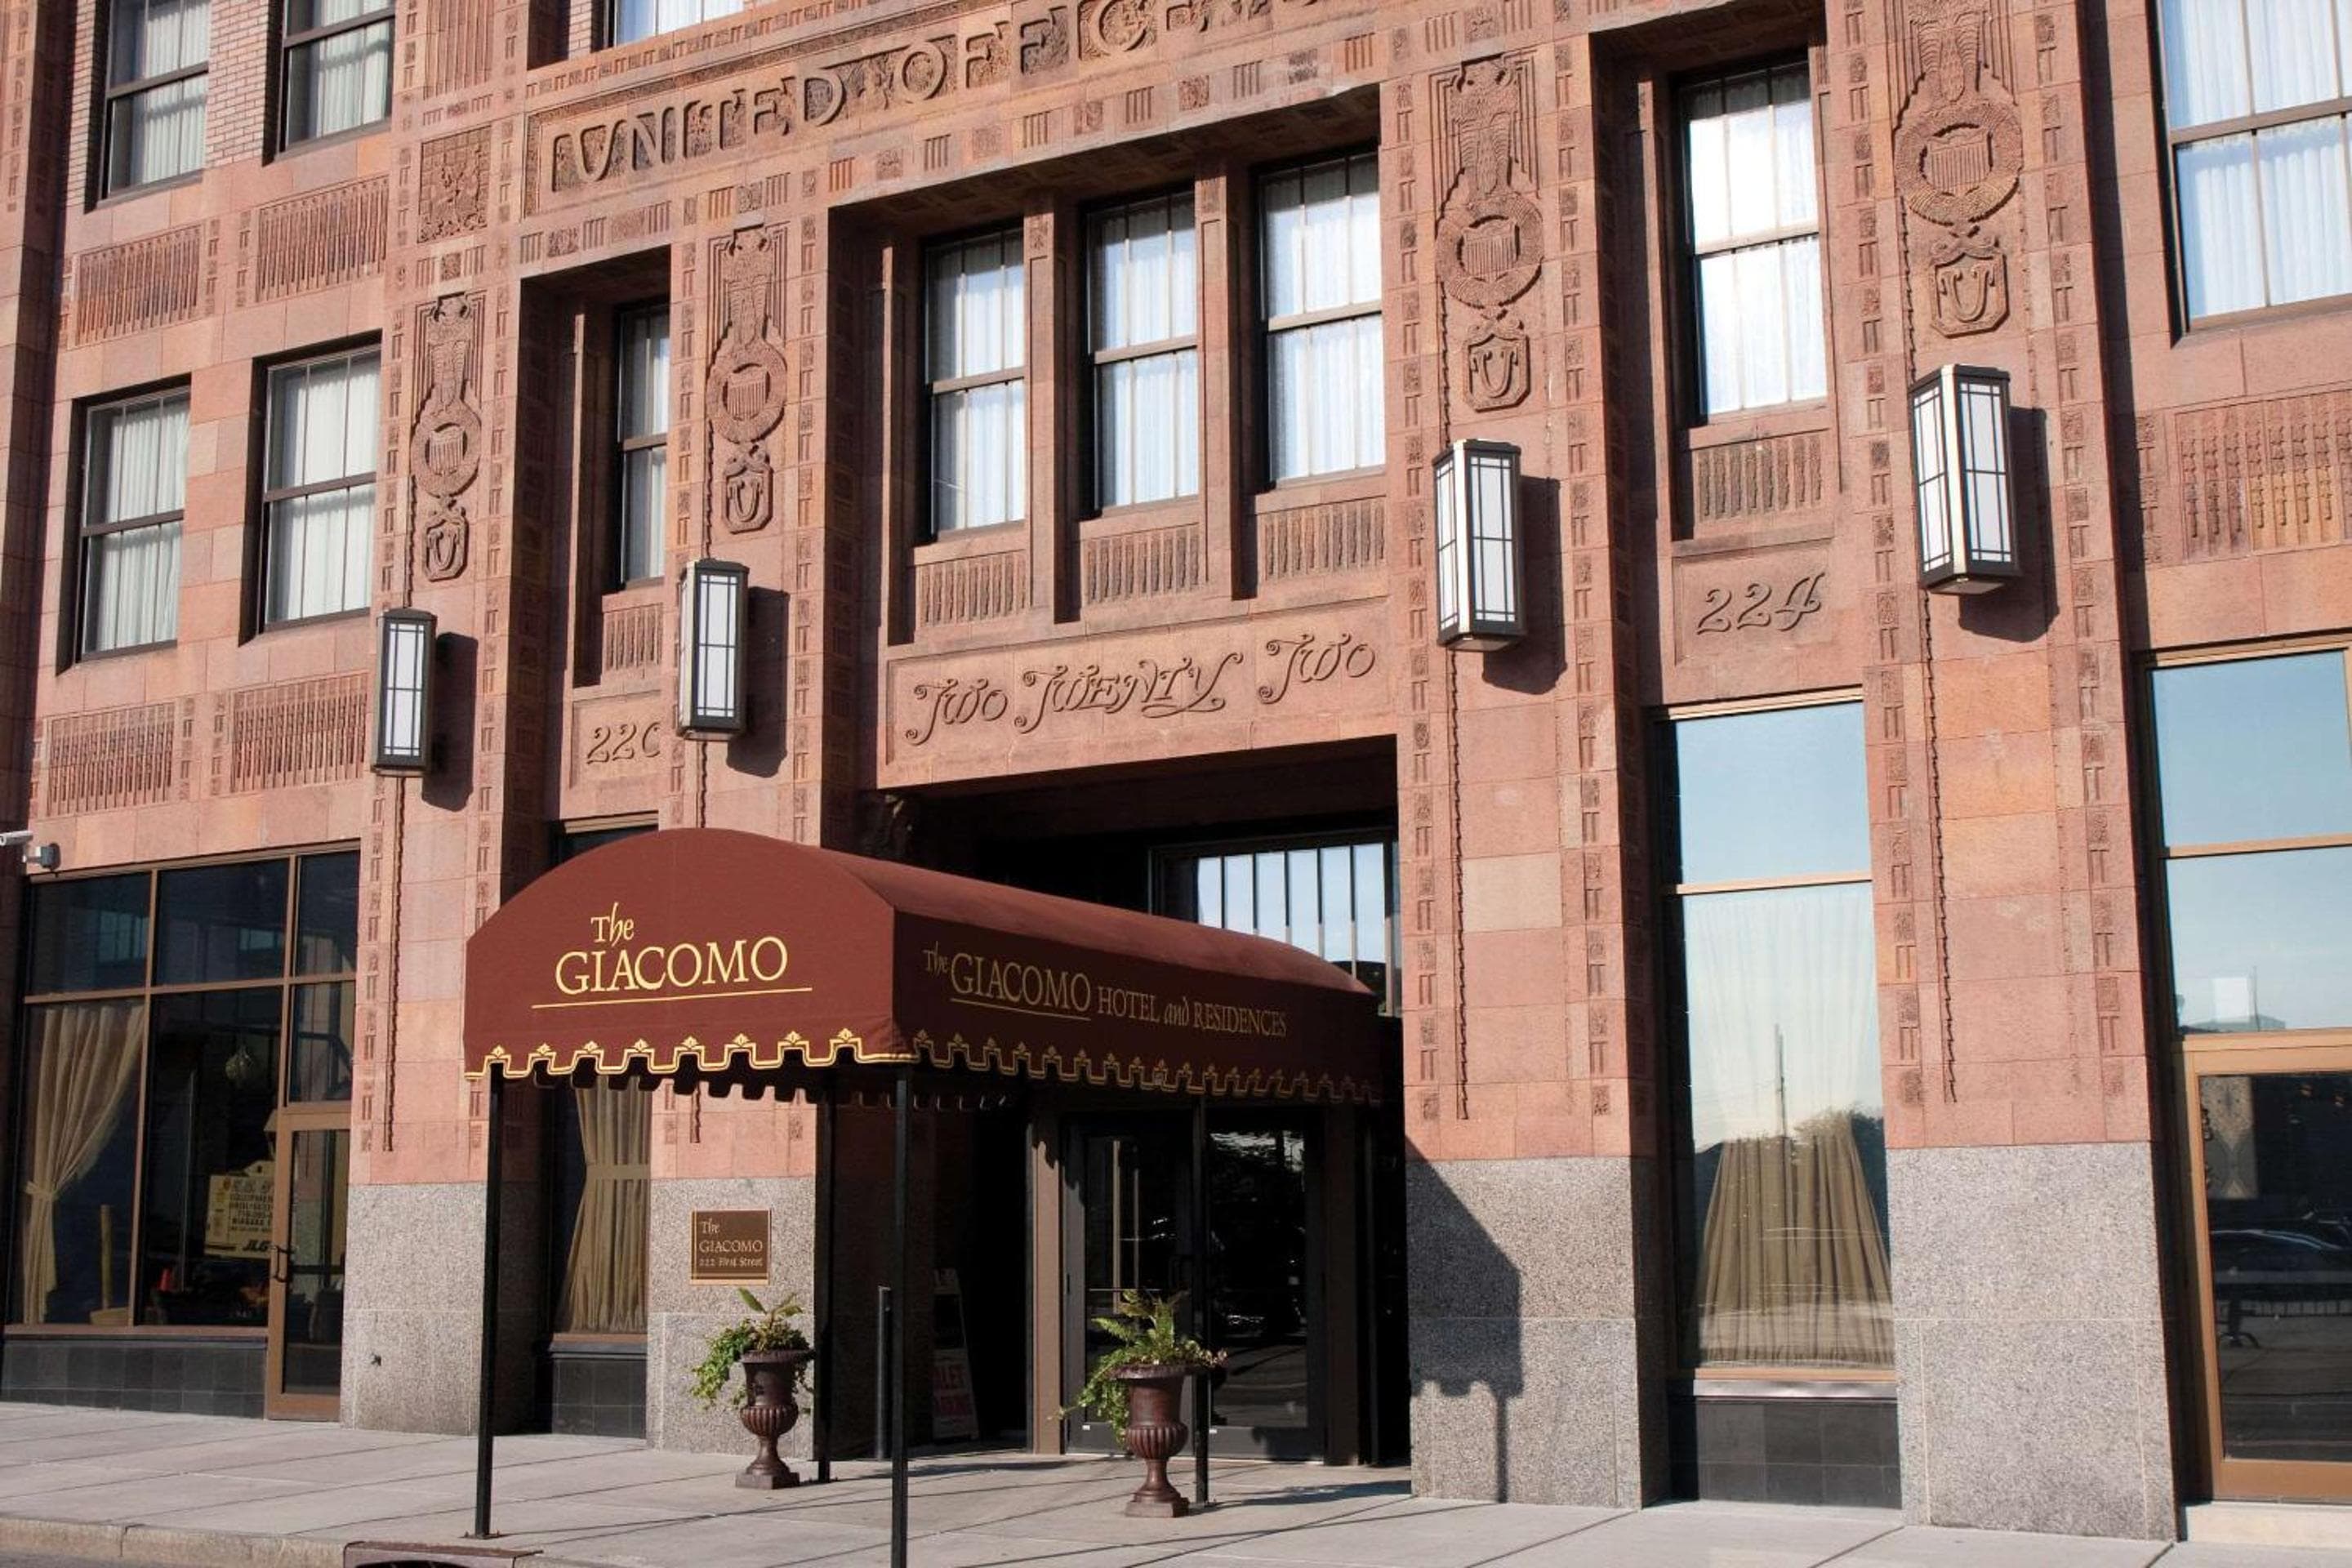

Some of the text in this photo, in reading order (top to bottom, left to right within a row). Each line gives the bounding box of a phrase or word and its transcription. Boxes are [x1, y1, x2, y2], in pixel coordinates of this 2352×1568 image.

[1696, 572, 1827, 635] 224
[905, 632, 1376, 746] TWO TWENTY TWO
[590, 902, 635, 947] The
[555, 935, 789, 995] GIACOMO
[922, 940, 1287, 1036] The GIACOMO HOTEL and RESIDENCES
[698, 1239, 764, 1254] GIACOMO
[701, 1218, 720, 1234] The
